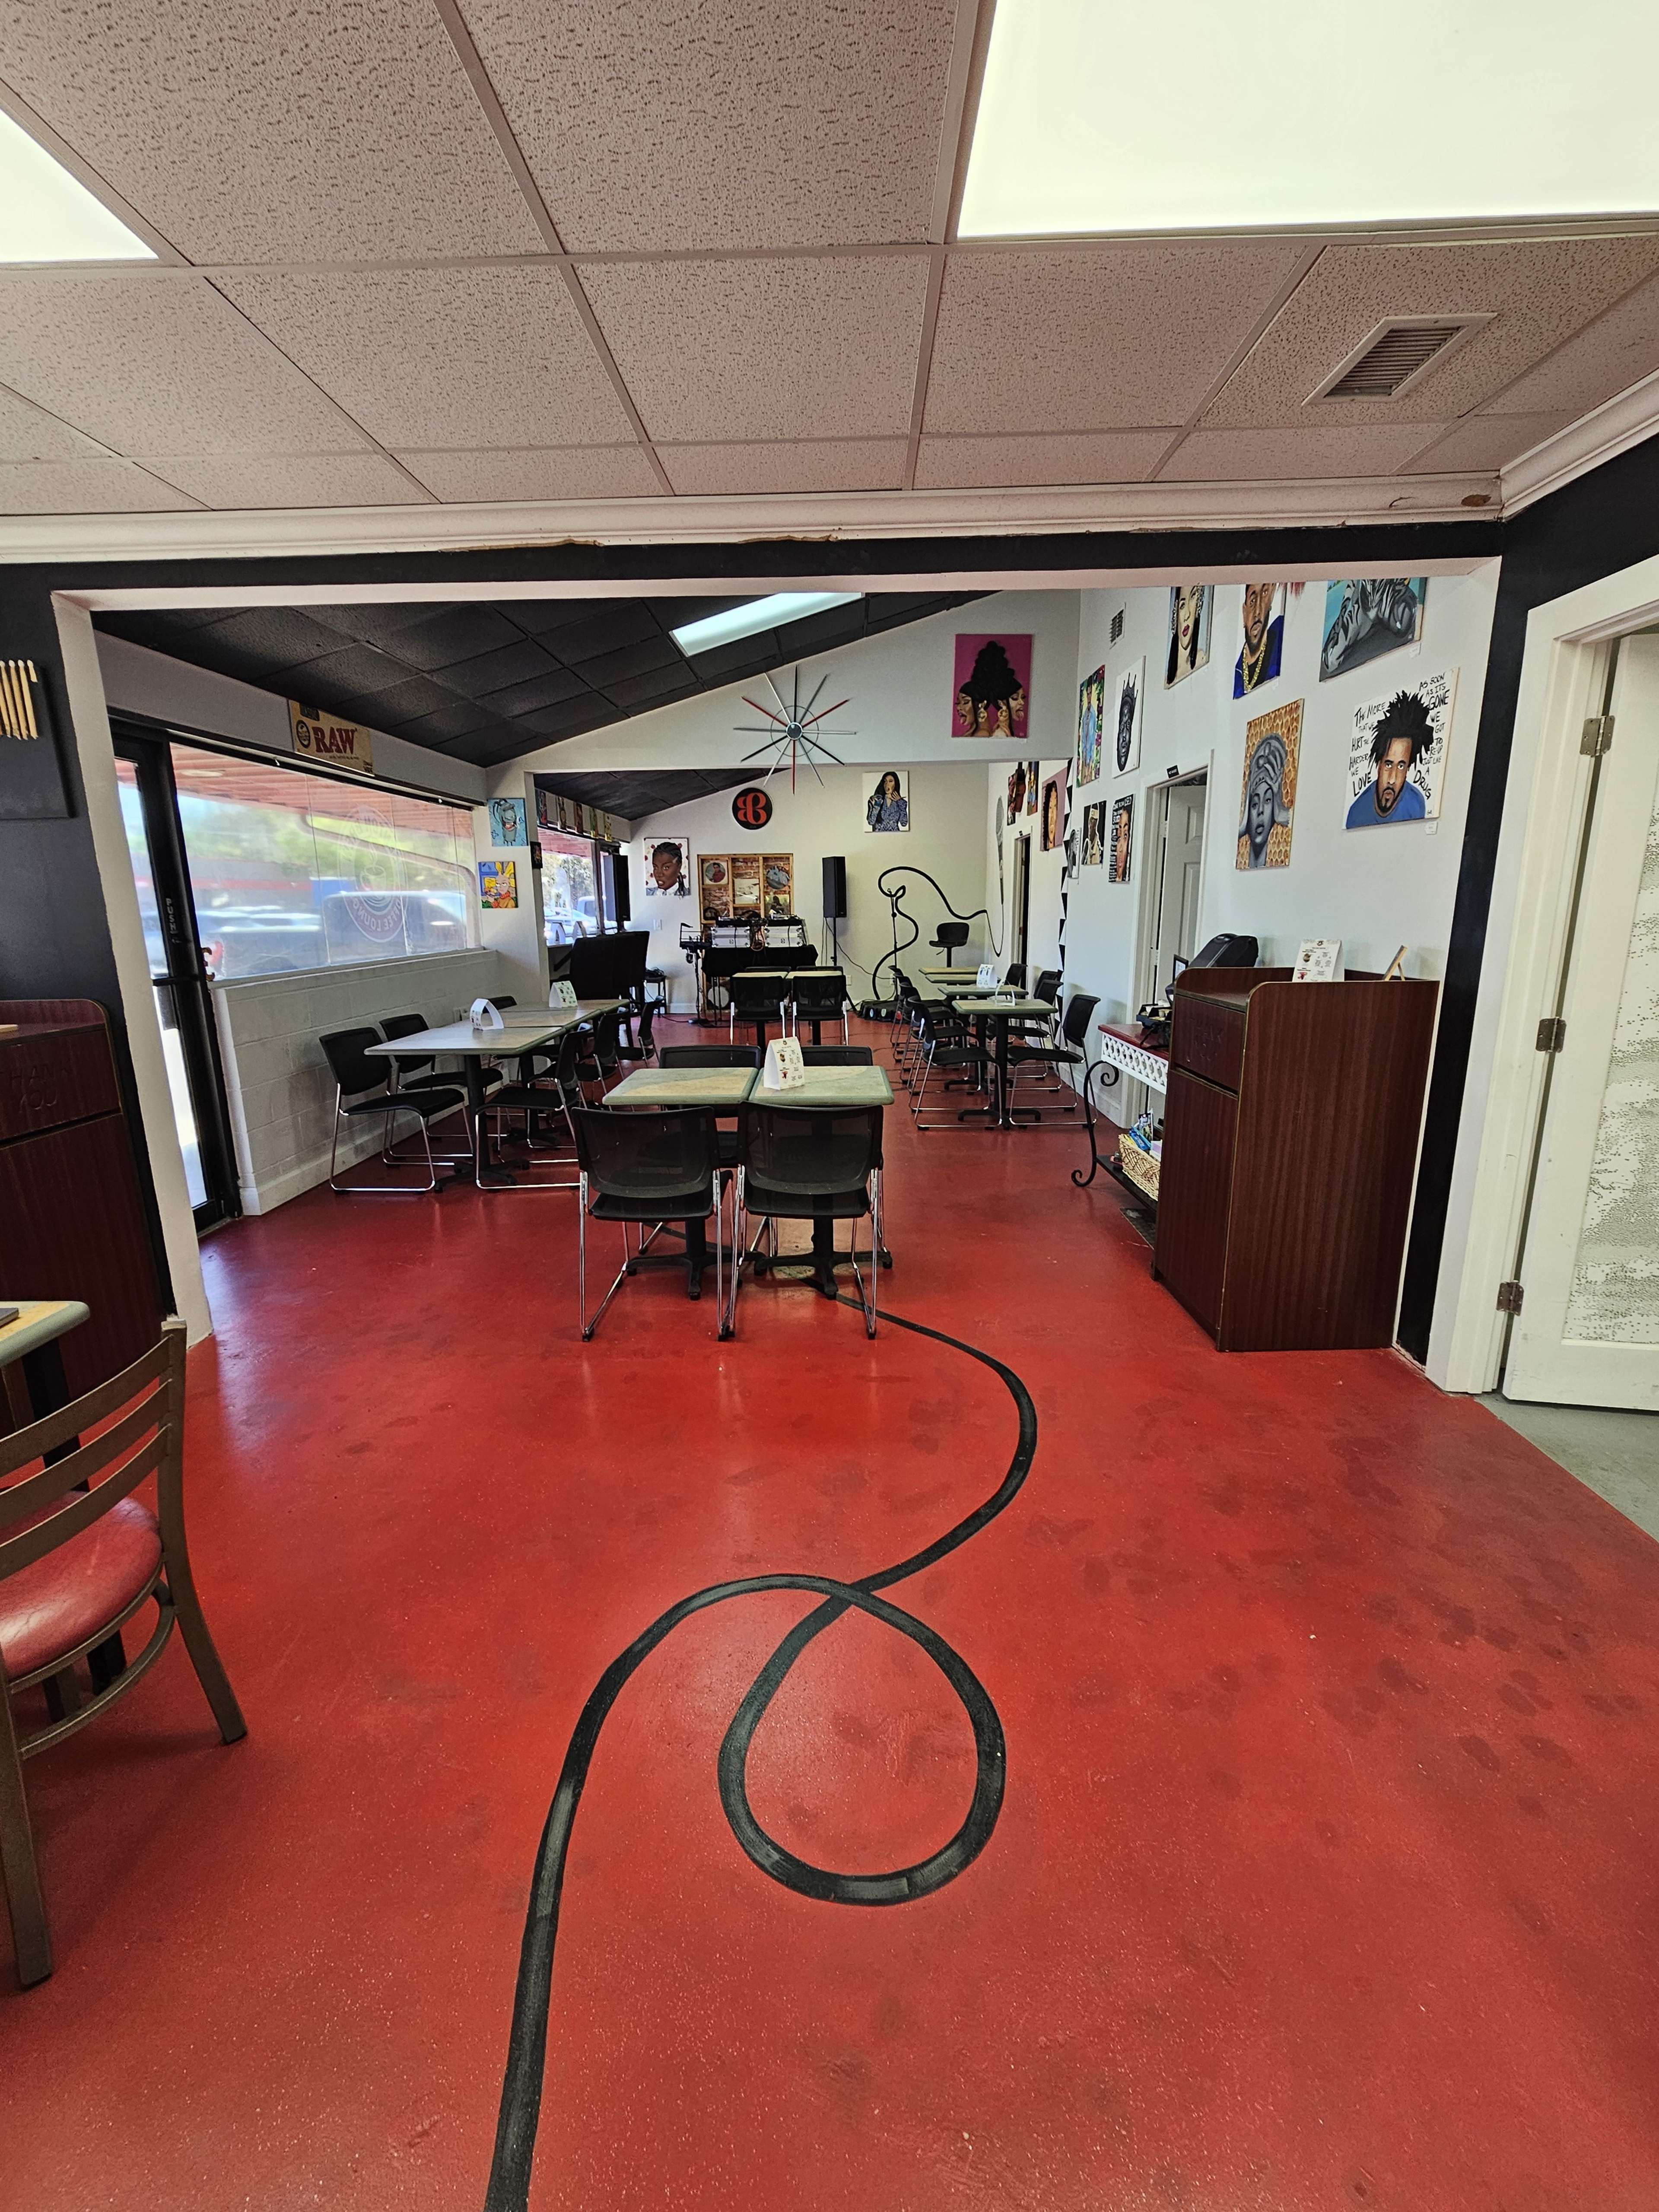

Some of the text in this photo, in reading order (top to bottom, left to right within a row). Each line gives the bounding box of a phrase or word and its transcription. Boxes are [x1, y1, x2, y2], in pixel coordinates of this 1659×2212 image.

[1419, 672, 1445, 692] AS SOON
[1426, 689, 1433, 697] AS
[1428, 689, 1450, 710] GONE
[1367, 702, 1386, 718] MORE
[1430, 711, 1440, 723] WE
[1434, 722, 1446, 733] GOT
[311, 726, 355, 755] RAW
[1434, 737, 1443, 746] TO
[1353, 772, 1372, 797] LOVE
[1413, 770, 1432, 800] DRUG
[166, 898, 176, 931] PUSH
